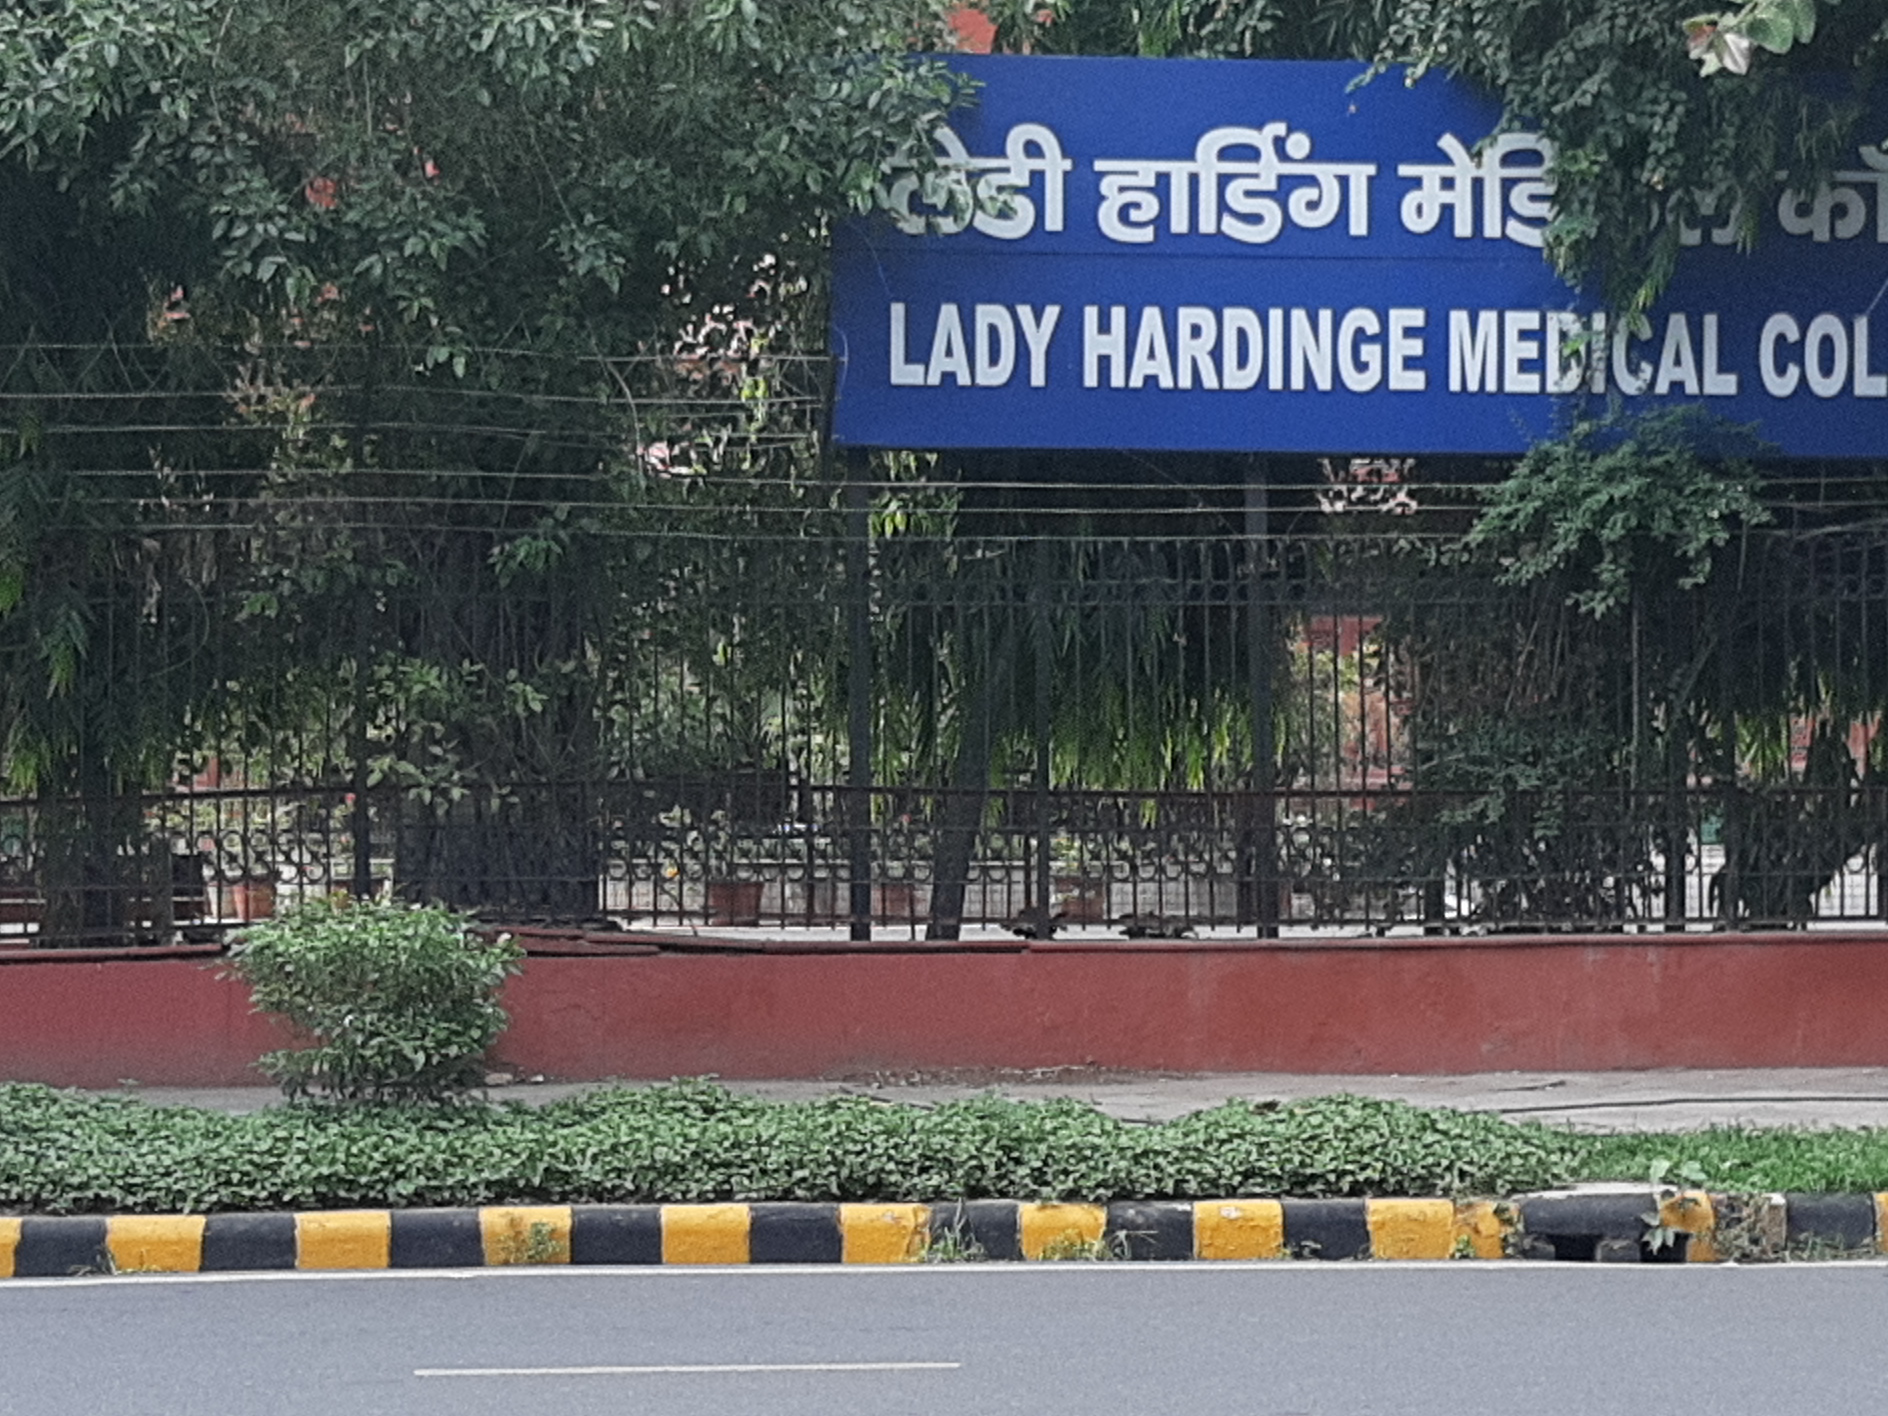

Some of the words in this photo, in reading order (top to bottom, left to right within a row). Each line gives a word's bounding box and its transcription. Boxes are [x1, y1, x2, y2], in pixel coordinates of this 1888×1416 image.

[1093, 122, 1378, 244] हार्डिंग
[890, 303, 1061, 386] LADY
[1083, 305, 1426, 392] HARDINGE
[1448, 309, 1738, 396] MEDICAL
